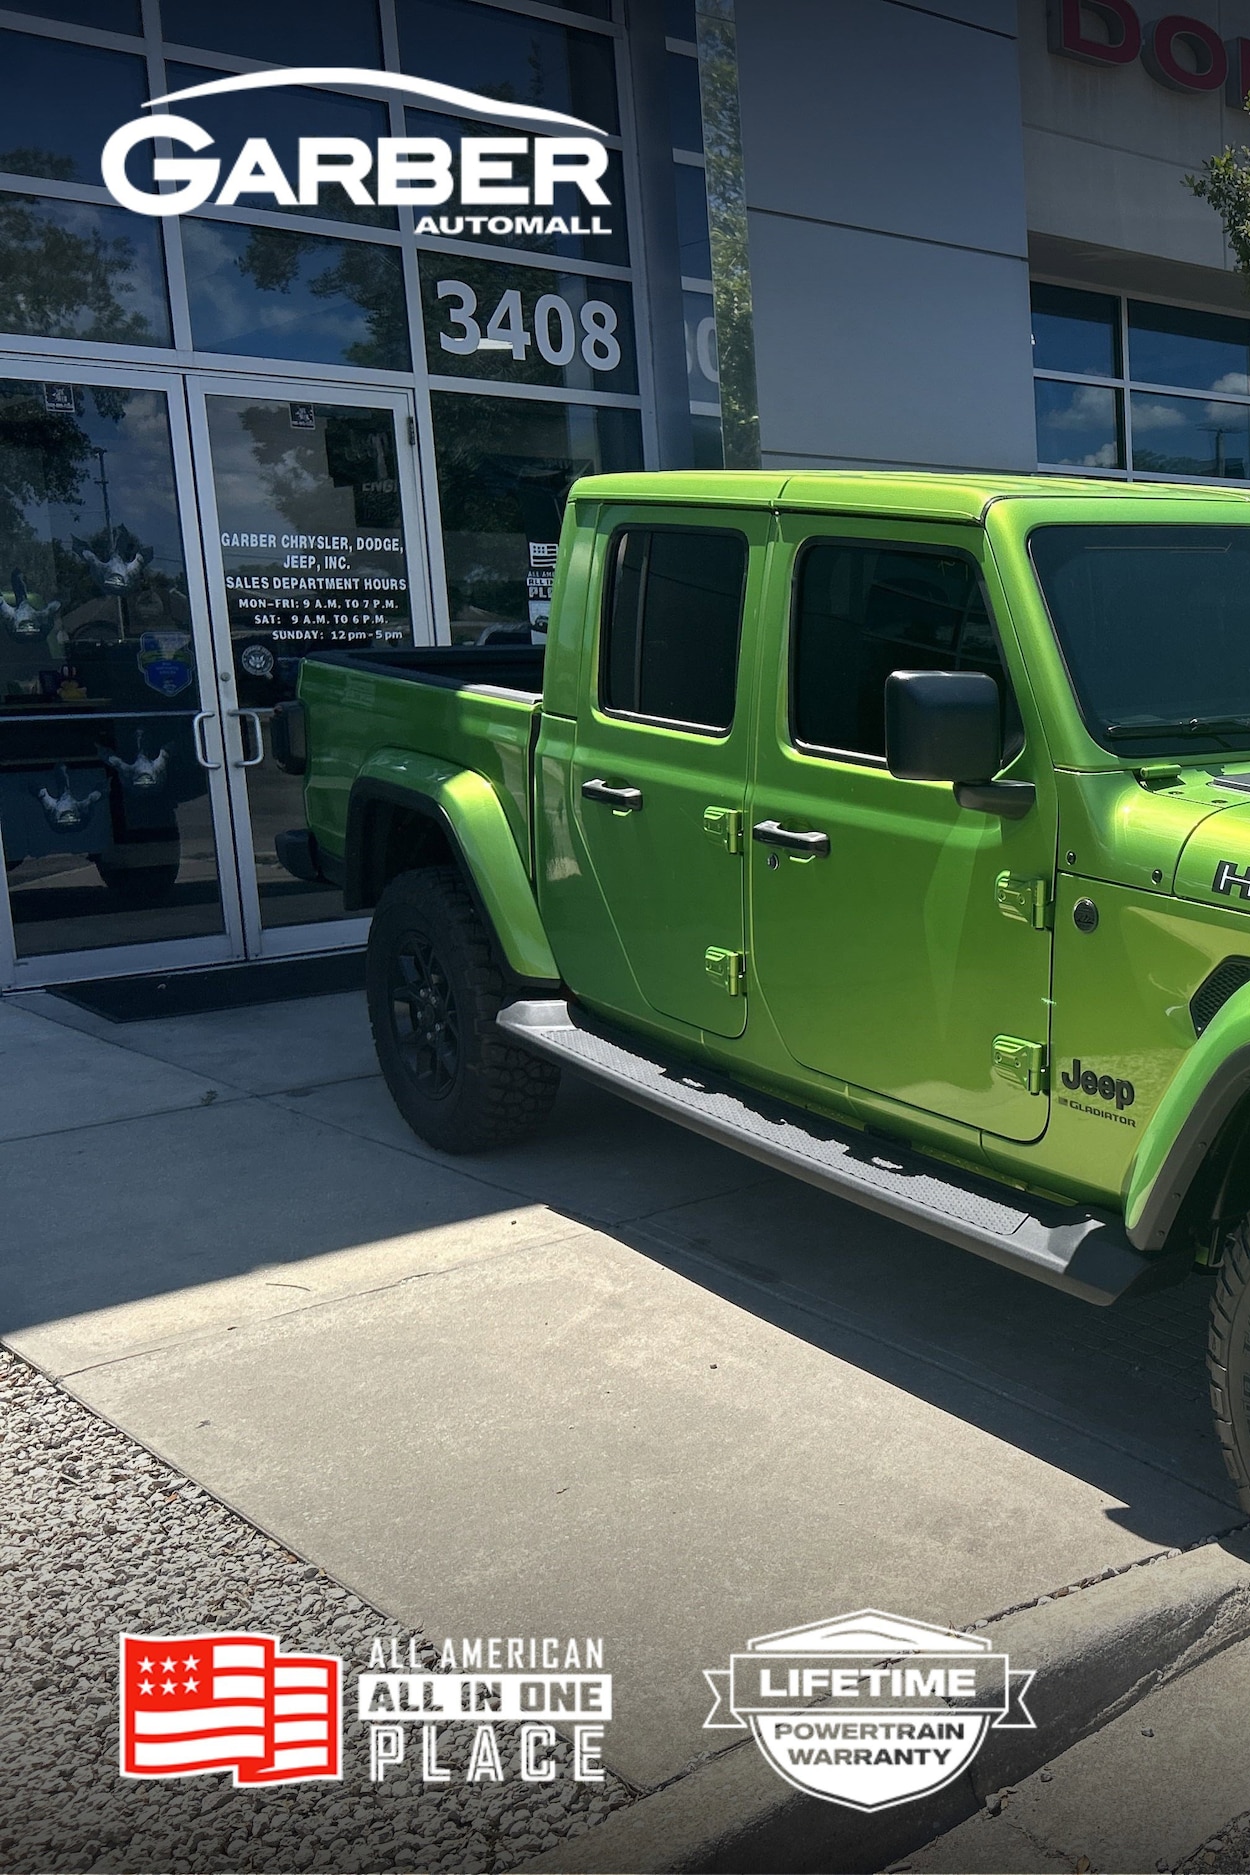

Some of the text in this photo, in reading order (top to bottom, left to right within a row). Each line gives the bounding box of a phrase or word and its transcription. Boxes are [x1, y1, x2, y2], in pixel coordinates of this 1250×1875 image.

[437, 280, 622, 371] 3408
[221, 533, 404, 554] GARBER CHRYSLER, DODGE,
[283, 555, 351, 572] JEEP, INC.
[226, 576, 407, 591] SALES DEPARTMENT HOURS
[303, 599, 310, 609] 9
[313, 599, 341, 610] A.M.
[345, 599, 359, 609] TO
[363, 600, 370, 609] 7
[373, 599, 399, 609] P.M.
[254, 614, 389, 625] SAT: 9 A.M. TO 6 P.M.
[272, 630, 324, 640] SUNDAY:
[331, 630, 346, 640] 12
[375, 630, 383, 640] 5
[1061, 1058, 1135, 1110] Jeep
[1069, 1100, 1137, 1128] GLADIATOR
